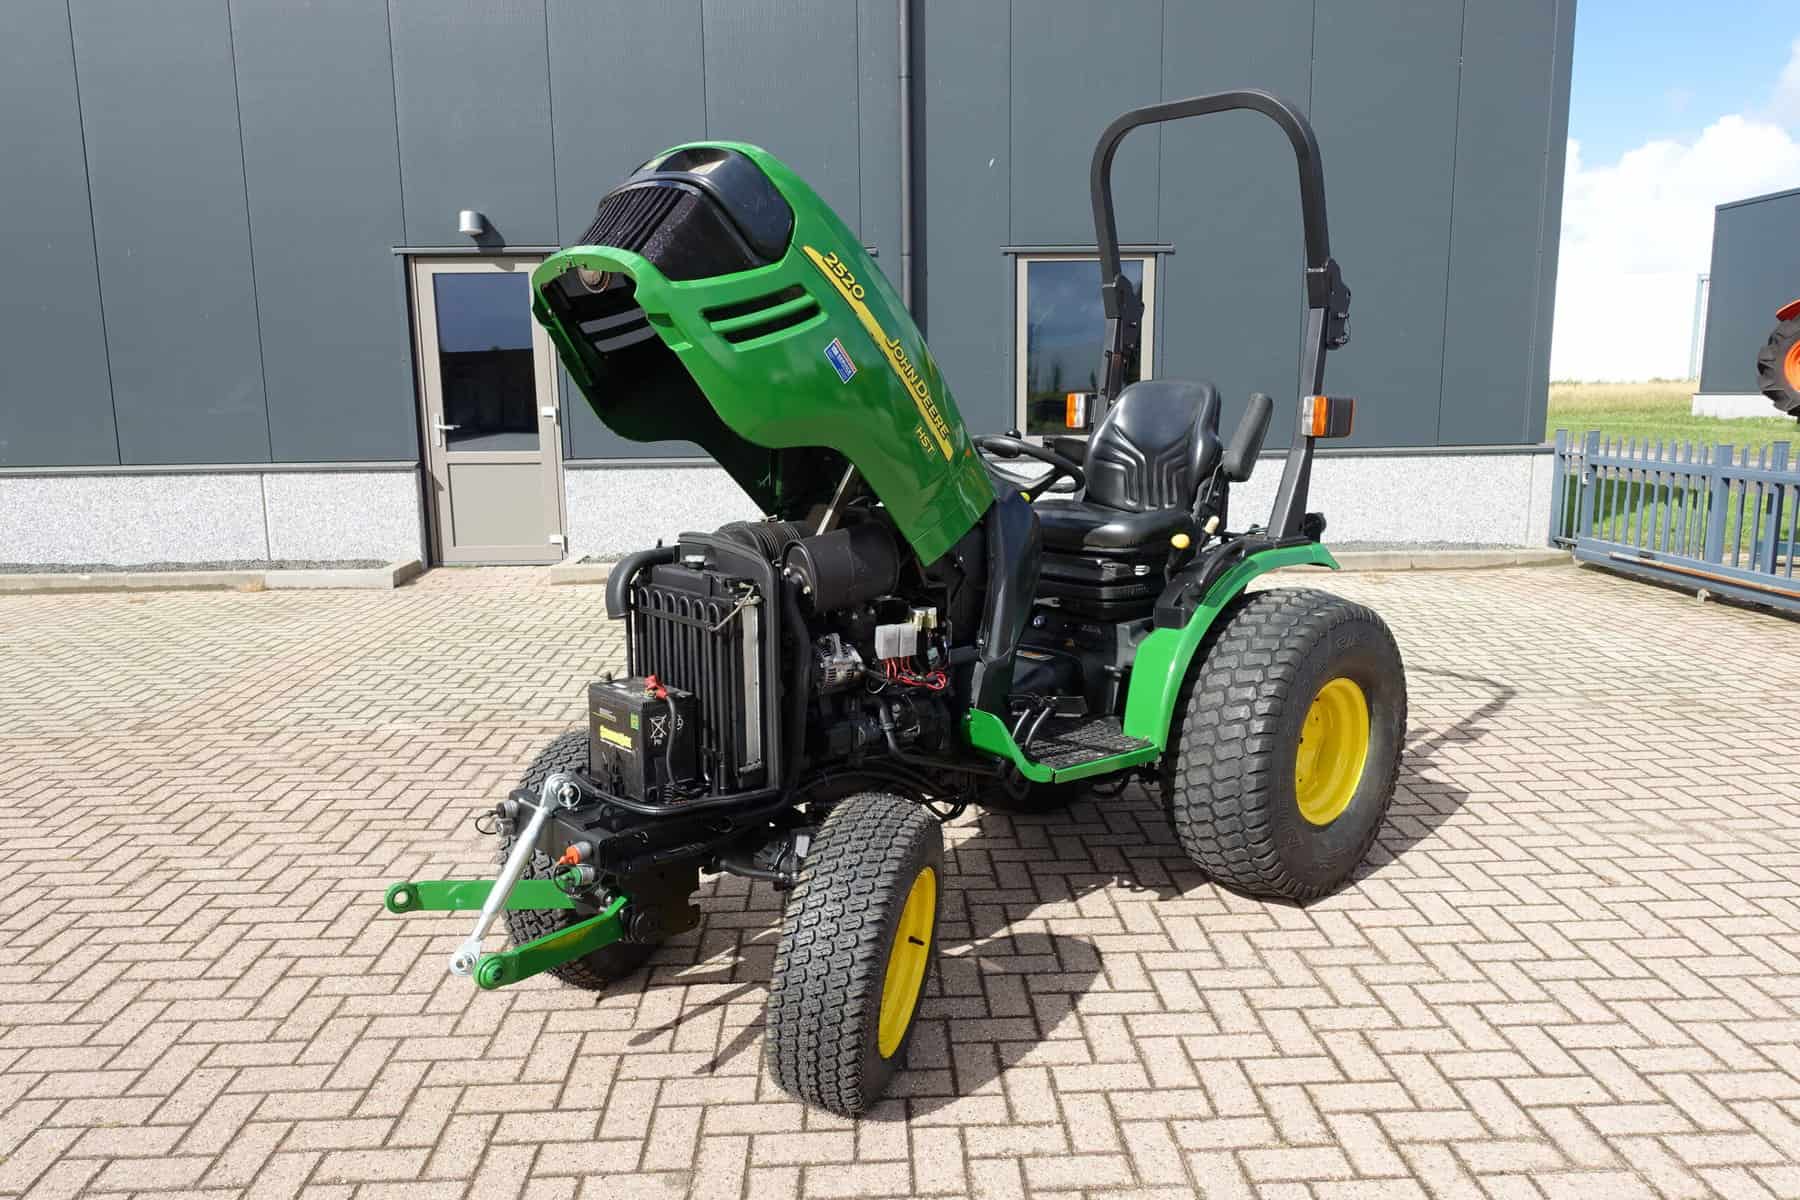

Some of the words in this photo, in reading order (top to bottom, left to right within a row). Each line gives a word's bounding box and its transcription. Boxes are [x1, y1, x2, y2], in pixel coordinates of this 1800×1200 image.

[823, 252, 865, 300] 2520
[886, 337, 919, 384] JOHN
[914, 378, 950, 440] DEERE
[915, 427, 936, 454] HST
